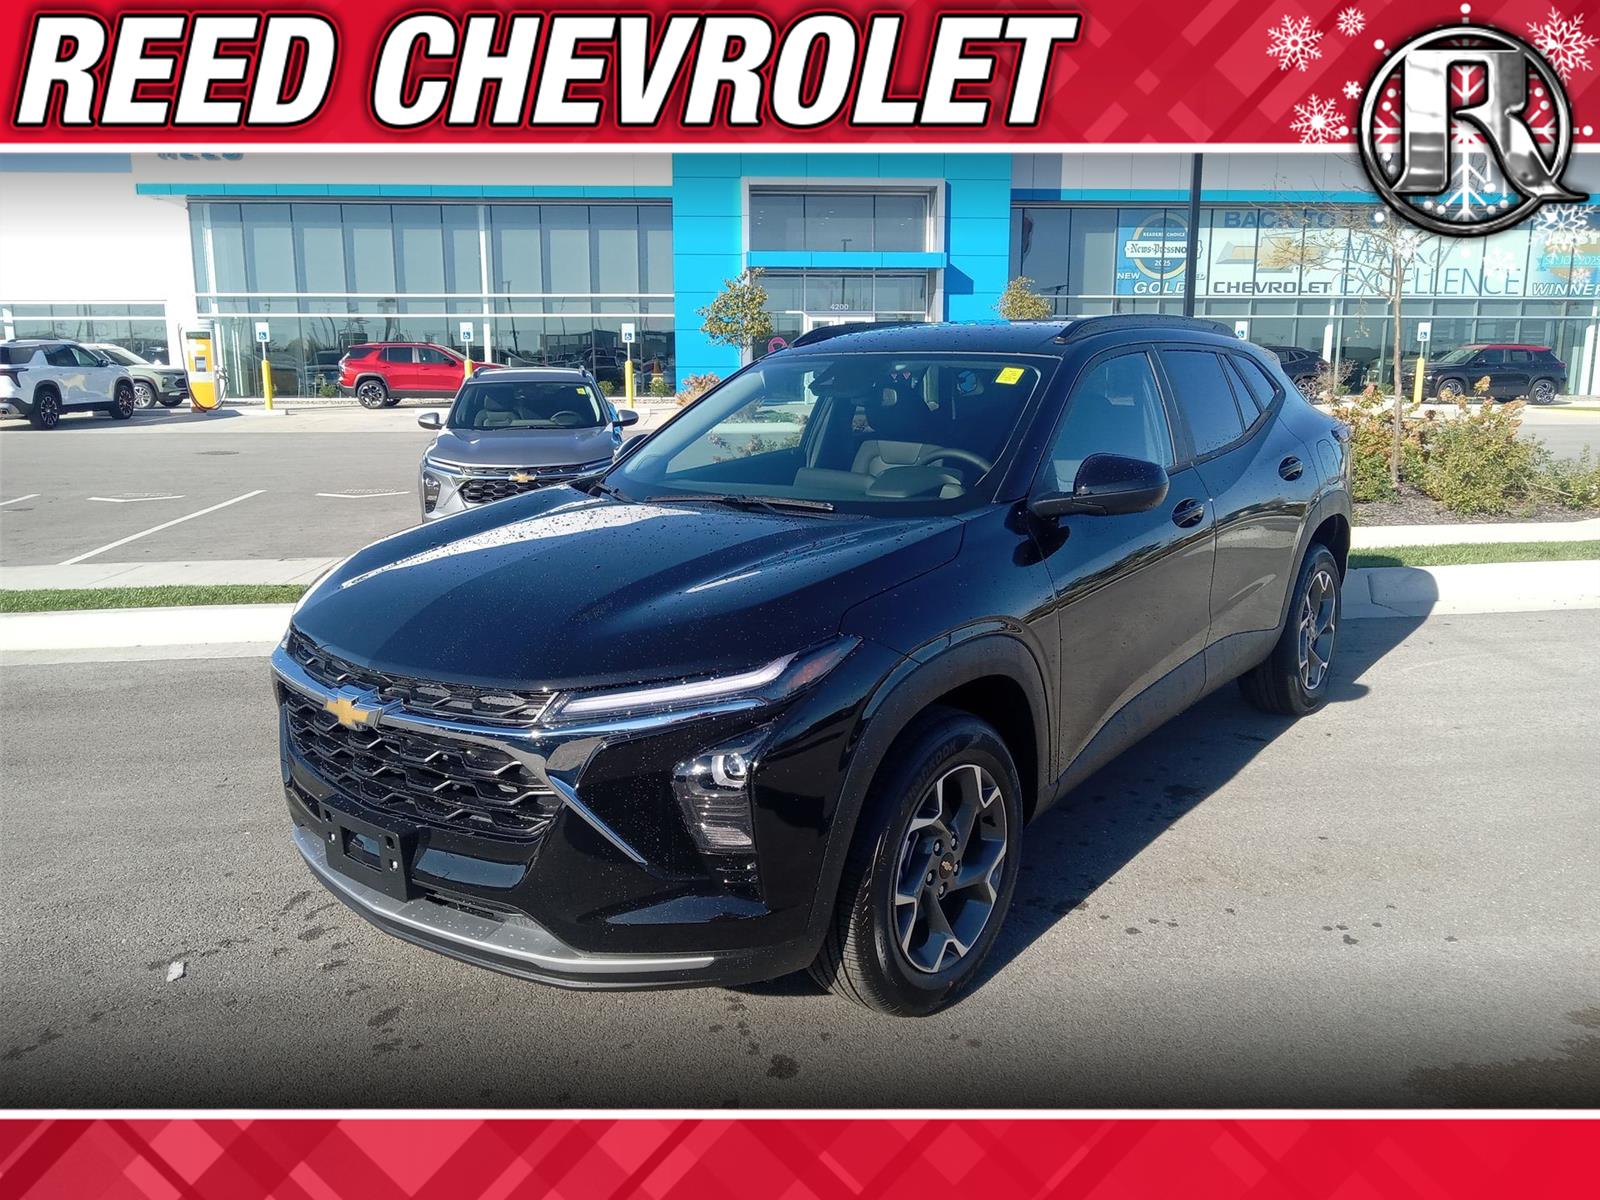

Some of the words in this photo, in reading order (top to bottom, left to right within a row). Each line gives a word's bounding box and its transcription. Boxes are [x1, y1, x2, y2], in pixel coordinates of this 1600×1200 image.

[1342, 237, 1427, 264] MAK
[1117, 272, 1140, 280] NEW
[1133, 281, 1185, 295] GOLD
[1213, 281, 1332, 294] CHEVROLET
[830, 303, 849, 311] 4200
